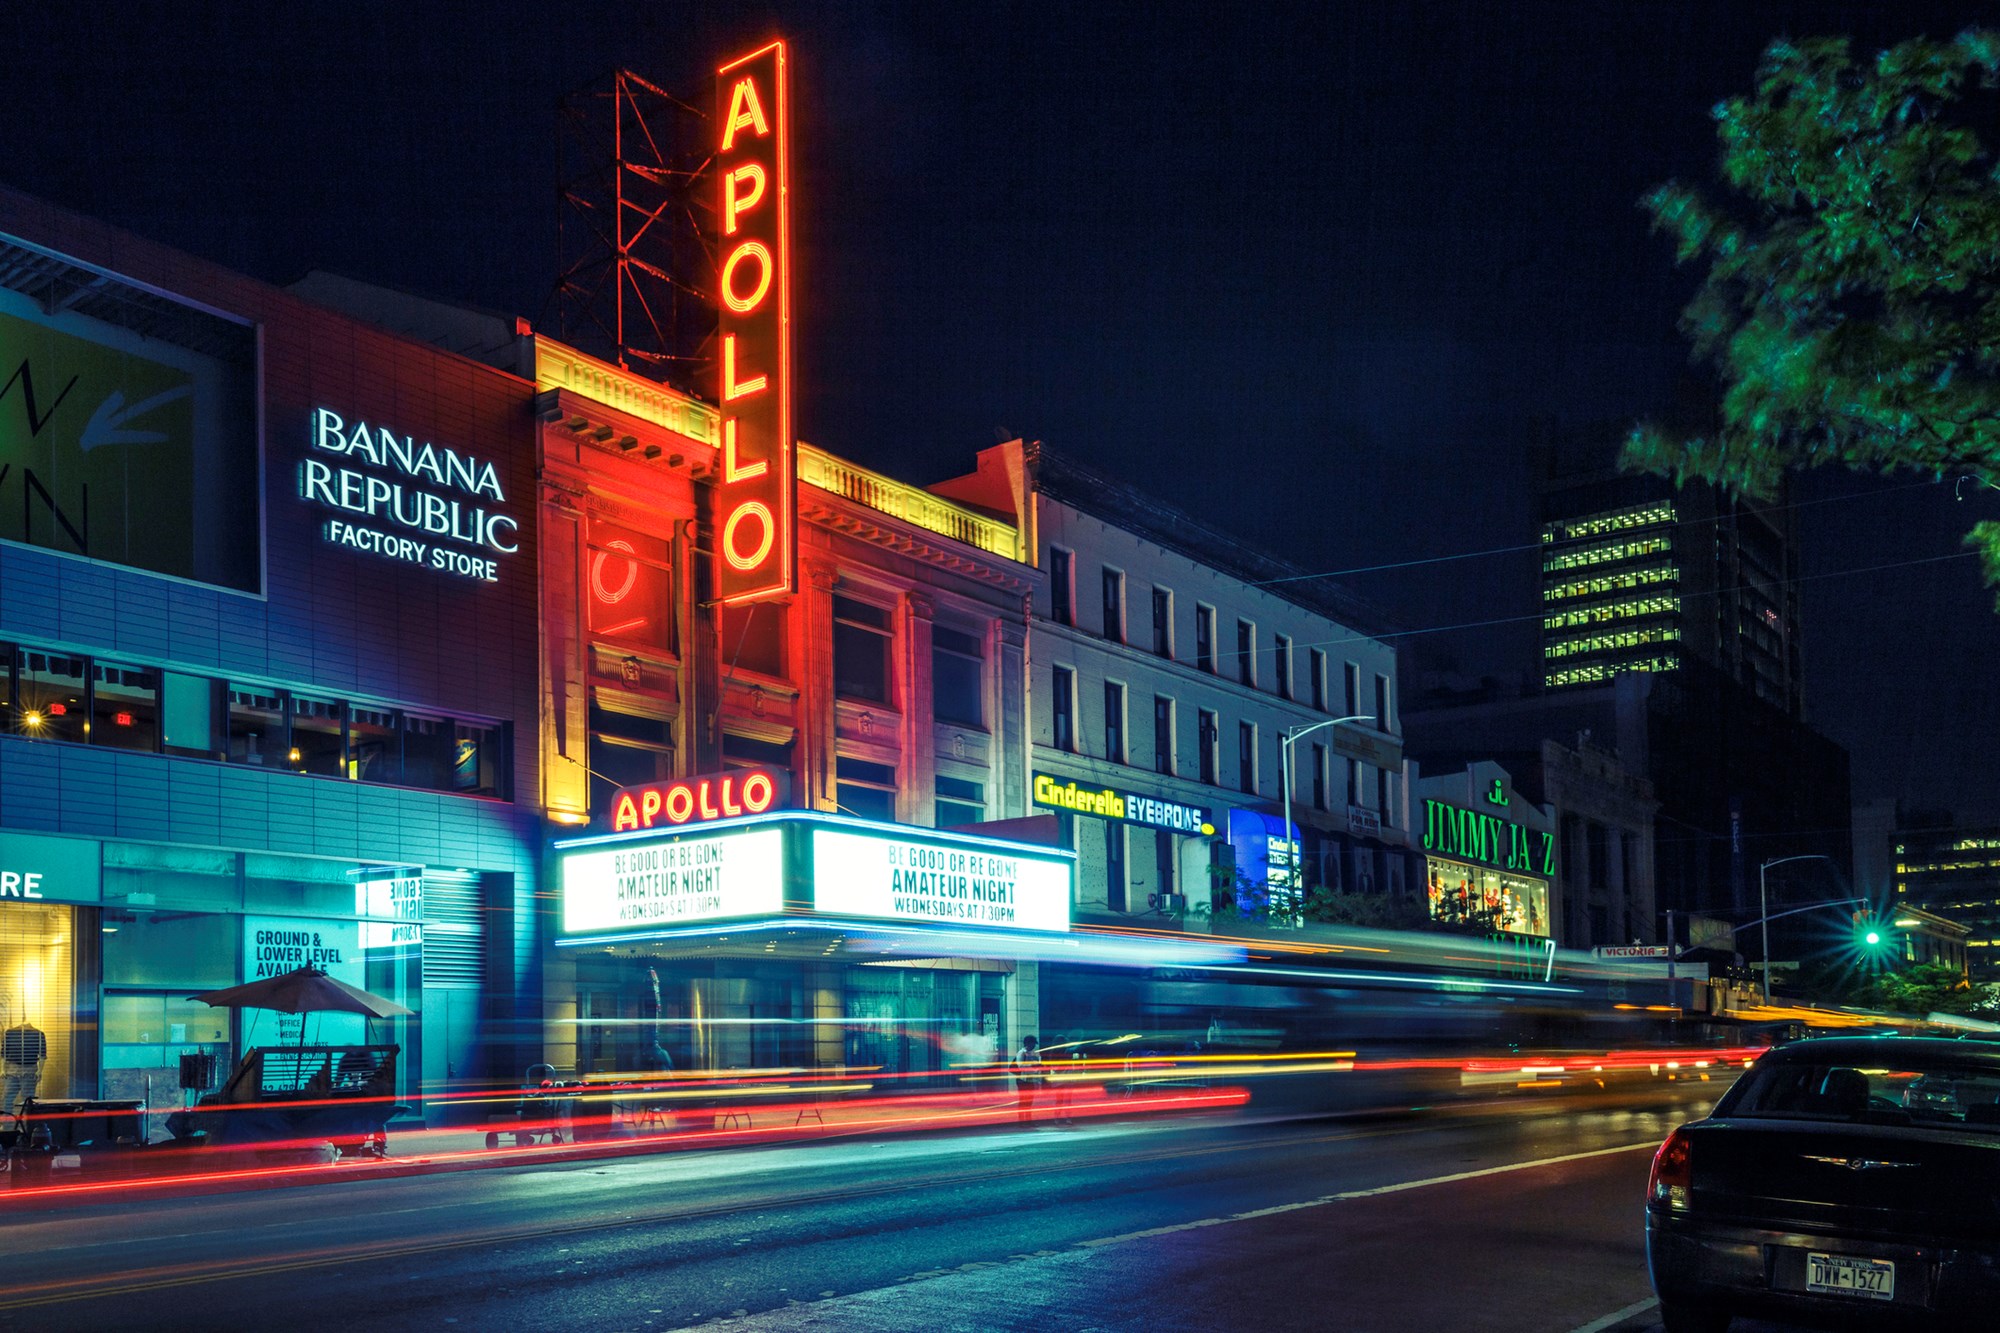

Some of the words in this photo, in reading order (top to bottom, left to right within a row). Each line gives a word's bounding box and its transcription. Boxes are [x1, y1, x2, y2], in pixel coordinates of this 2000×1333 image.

[720, 77, 774, 571] APOLLO
[313, 407, 505, 502] BANANA
[303, 458, 518, 553] REPUBLIC
[329, 520, 426, 563] FACTORY
[431, 547, 499, 582] STORE
[614, 773, 773, 831] APOLLO
[1034, 775, 1124, 818] Cinderella
[1126, 794, 1202, 832] EYEBROWS
[1423, 799, 1503, 865] JIMMY
[1508, 823, 1555, 876] JAZ
[615, 854, 627, 874] BE
[630, 850, 658, 873] GOOD
[662, 848, 676, 869] OR
[680, 846, 692, 867] BE
[696, 842, 724, 865] GONE
[888, 844, 904, 866] BE
[909, 847, 945, 871] GOOD
[949, 852, 966, 873] OR
[970, 855, 984, 876] BE
[988, 857, 1018, 880] GONE
[0, 871, 43, 899] RE
[617, 871, 678, 901] AMATEUR
[682, 866, 721, 894] NIGHT
[892, 868, 968, 900] AMATEUR
[972, 877, 1015, 905] NIGHT
[619, 900, 675, 920] WEDNESDAS
[677, 899, 686, 914] AT
[690, 896, 721, 914] 730PM
[893, 896, 965, 918] WEDNESDAYS
[966, 903, 979, 919] AT
[256, 930, 310, 946] GROUND
[313, 932, 322, 947] &
[256, 946, 303, 962] LOWER
[306, 947, 342, 963] LEVEL
[1606, 946, 1655, 957] VICTORIA
[256, 962, 328, 977] AVAILE
[280, 1019, 300, 1028] OFFICE
[280, 1030, 306, 1039] MEDIC
[1851, 1268, 1884, 1291] 1527
